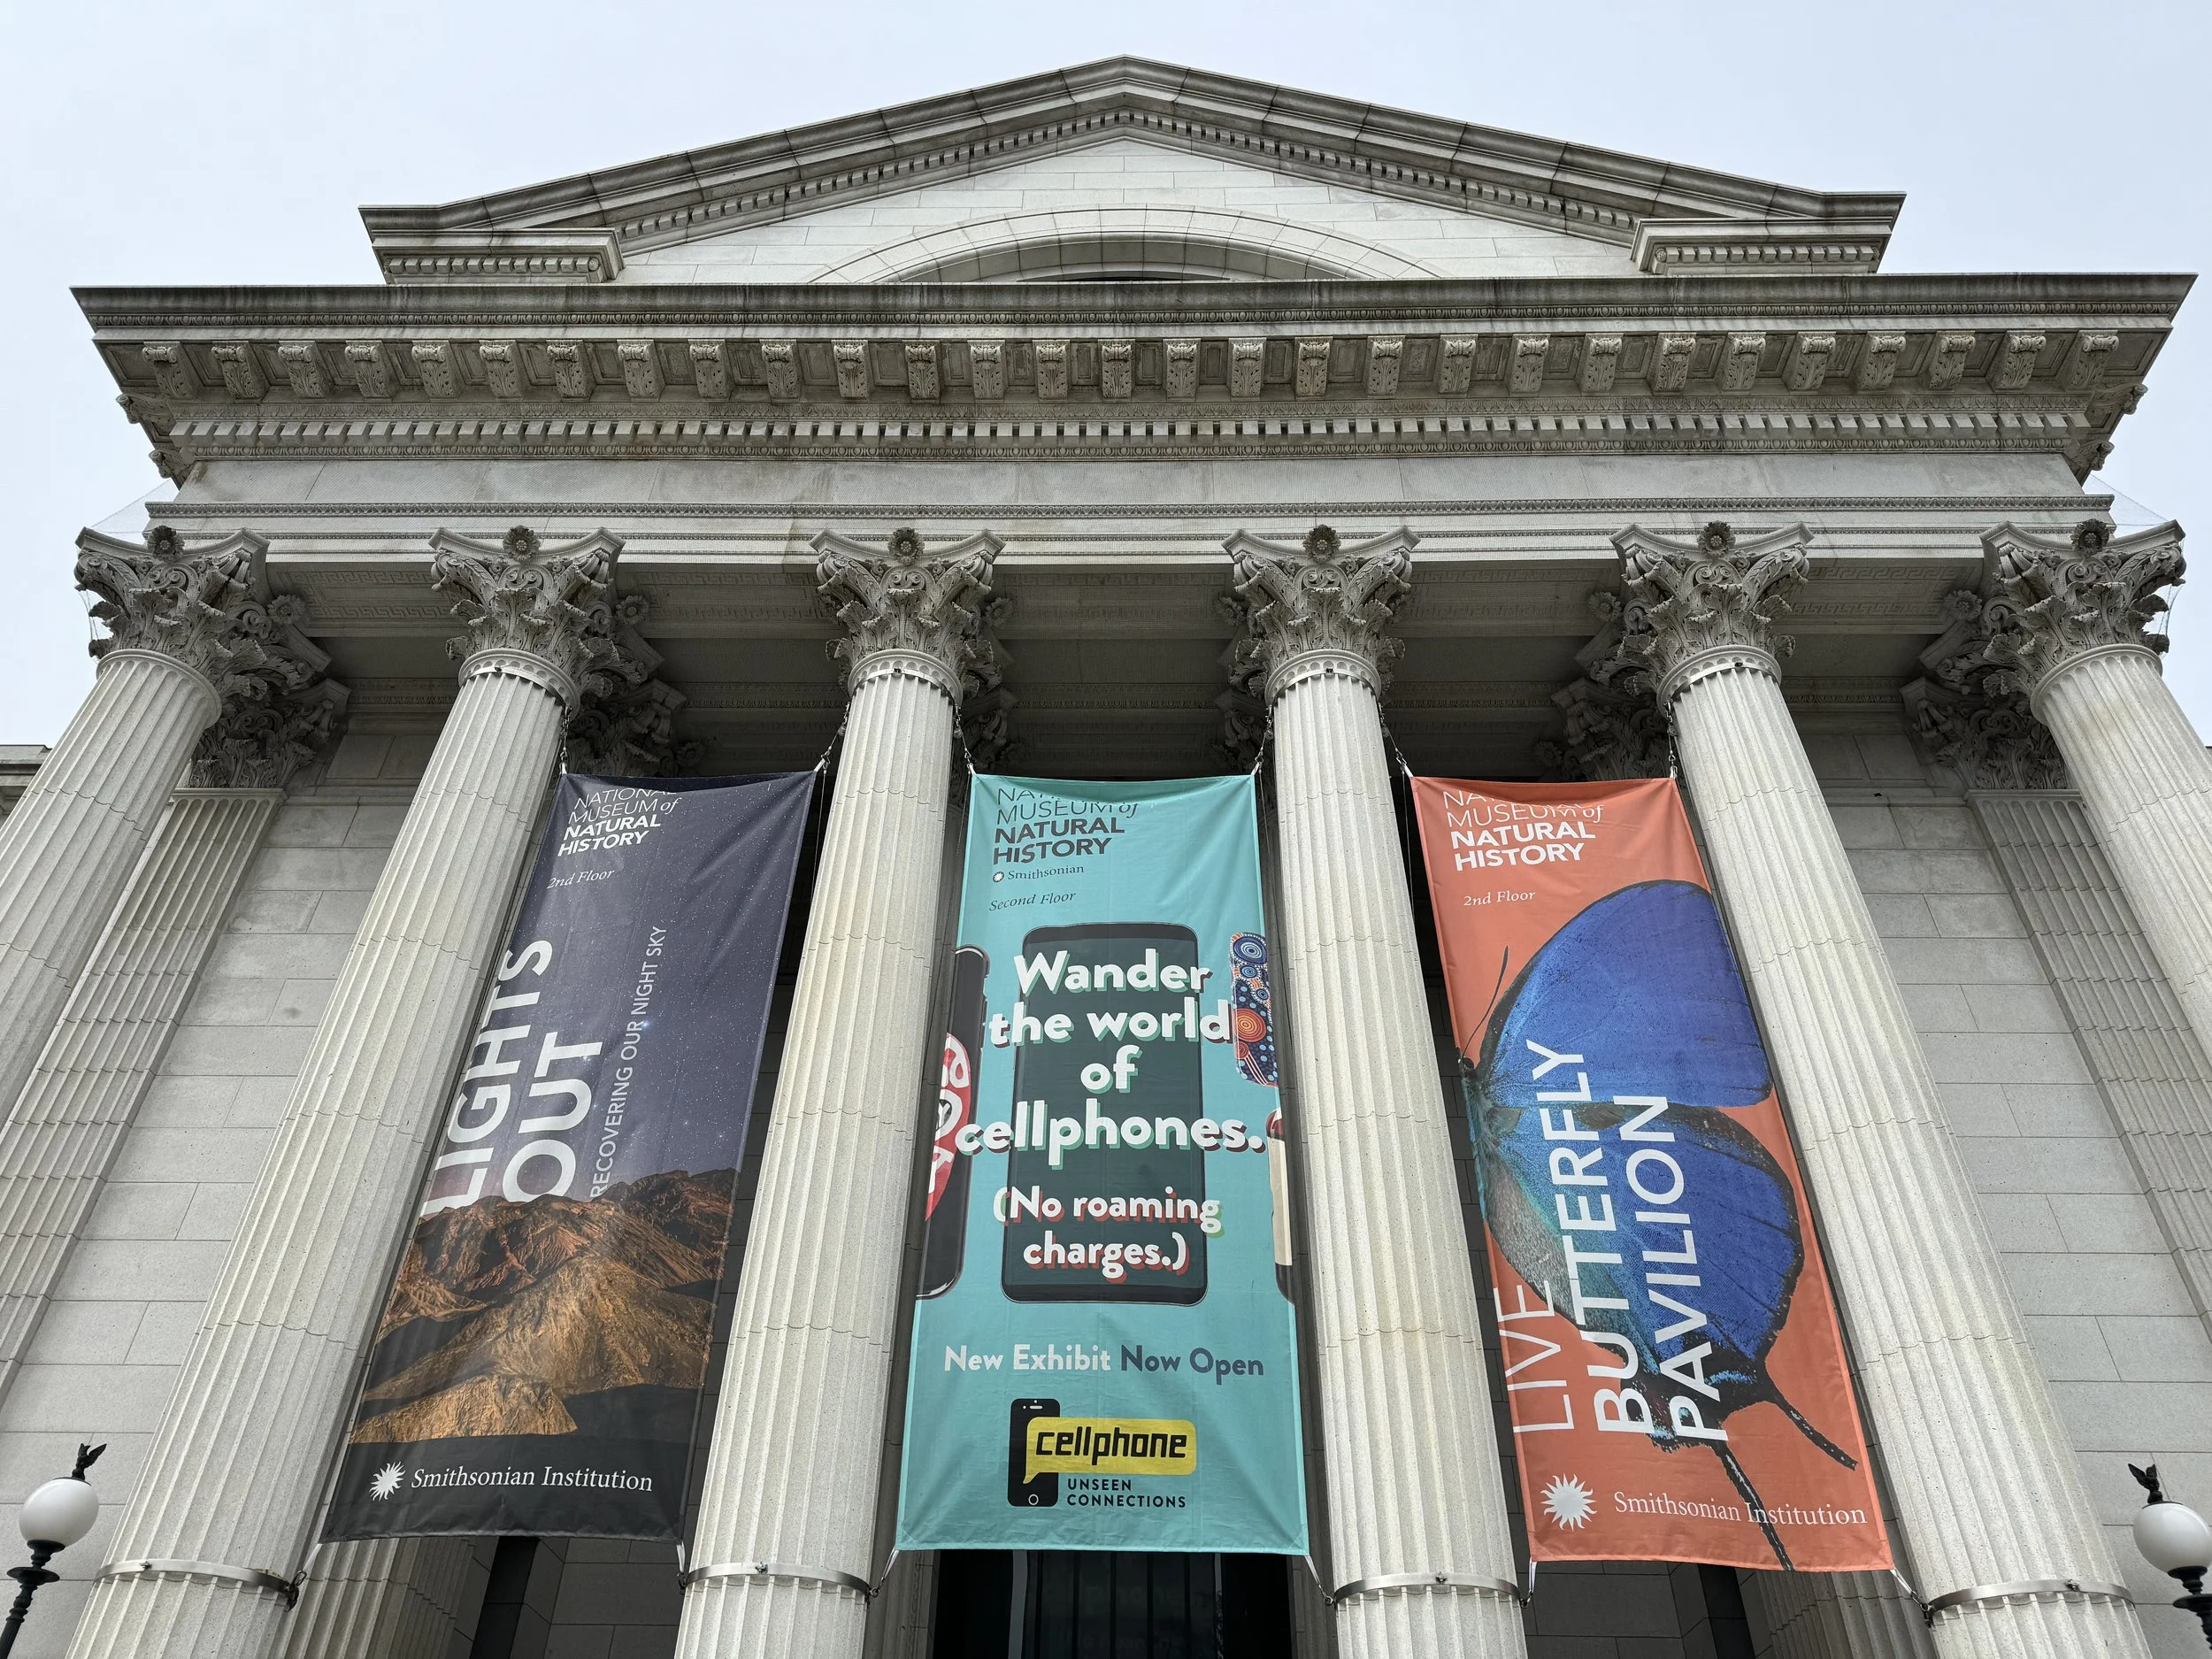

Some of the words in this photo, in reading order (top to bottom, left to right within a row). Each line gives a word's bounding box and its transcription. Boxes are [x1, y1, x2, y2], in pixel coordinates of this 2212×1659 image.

[568, 799, 658, 824] MUSEUM
[659, 796, 683, 815] of
[573, 787, 677, 810] NATION
[996, 800, 1112, 826] MUSEUM
[564, 814, 662, 841] NATURAL
[995, 817, 1125, 844] NATURAL
[1447, 803, 1577, 828] MUSEUM
[1582, 804, 1606, 823] of
[557, 830, 649, 856] HISTORY
[1450, 821, 1596, 849] NATURAL
[993, 837, 1112, 865] HISTORY
[1453, 842, 1585, 872] HISTORY
[546, 872, 575, 889] 2nd
[576, 868, 615, 885] Floor
[1007, 865, 1085, 881] Smithsonian
[988, 894, 1037, 911] Second
[1041, 891, 1077, 906] Floor
[1463, 891, 1492, 906] 2nd
[1497, 890, 1536, 903] Floor
[645, 926, 668, 957] SKY
[1014, 948, 1211, 995] Wander
[631, 962, 658, 1016] NIGHT
[988, 1001, 1072, 1047] the
[1087, 996, 1233, 1042] world
[620, 1020, 644, 1060] OUR
[421, 939, 553, 1218] LIGHTS
[1080, 1044, 1141, 1092] of
[502, 1031, 603, 1202] OUT
[589, 1066, 634, 1199] RECOVERING
[955, 1098, 1266, 1169] cellphones.
[993, 1186, 1064, 1223] (No
[1073, 1186, 1222, 1235] roaming
[1525, 1039, 1655, 1434] BUTTERFLY
[1023, 1230, 1188, 1280] charges.)
[1612, 1095, 1729, 1441] PAVILION
[944, 1344, 1004, 1371] New
[1013, 1343, 1112, 1371] Exhibit
[1120, 1344, 1182, 1372] Now
[1189, 1348, 1264, 1386] Open
[1493, 1279, 1575, 1433] LIVE
[1035, 1426, 1187, 1466] cellphone
[410, 1464, 535, 1490] Smithsonian
[541, 1466, 654, 1493] Institution
[1067, 1479, 1133, 1492] UNSEEN
[1066, 1494, 1187, 1509] CONNECTIONS
[1614, 1491, 1741, 1522] Smithsonian
[1747, 1502, 1869, 1525] Institution
